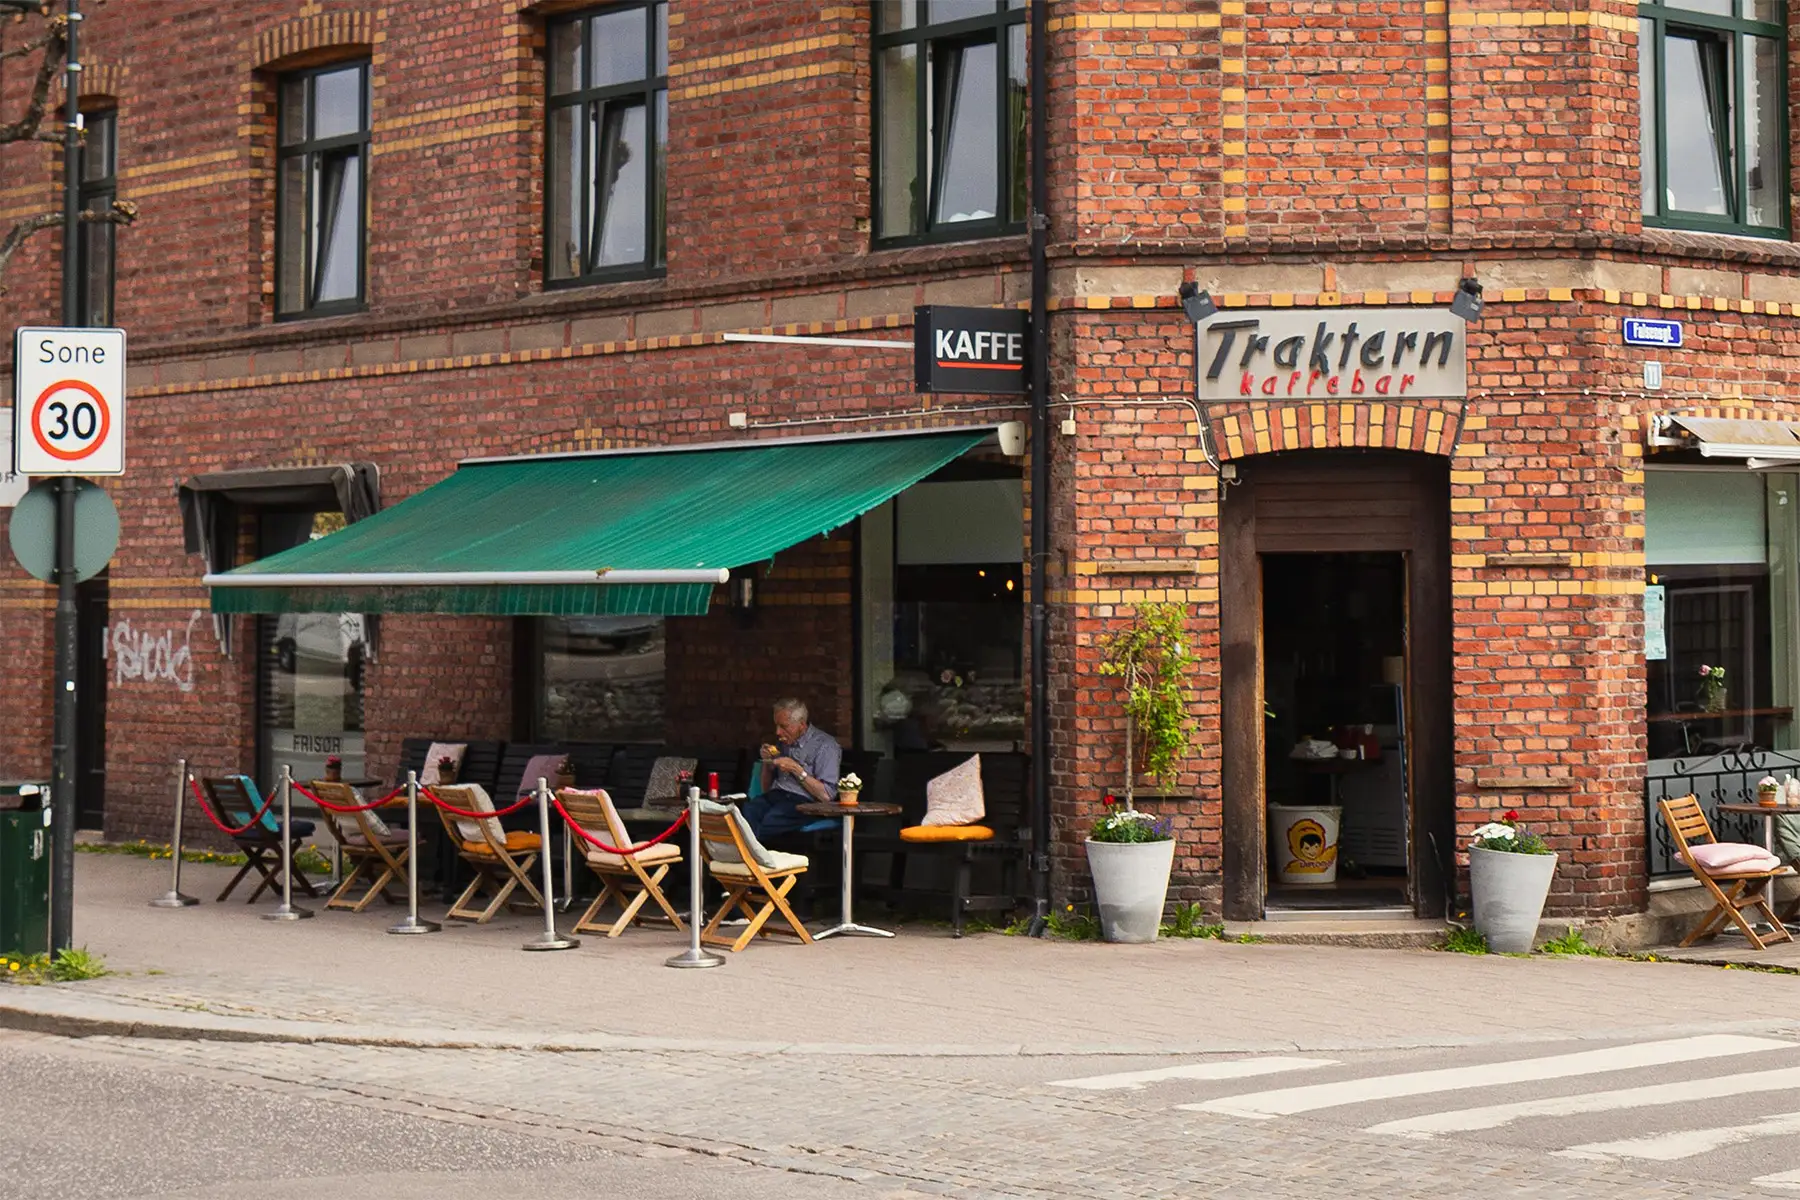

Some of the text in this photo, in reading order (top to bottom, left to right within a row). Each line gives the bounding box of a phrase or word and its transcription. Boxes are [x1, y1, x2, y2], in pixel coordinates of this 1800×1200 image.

[39, 340, 105, 364] Sone
[935, 329, 1023, 361] KAFFE
[1206, 319, 1453, 379] Traktern
[48, 402, 96, 440] 30
